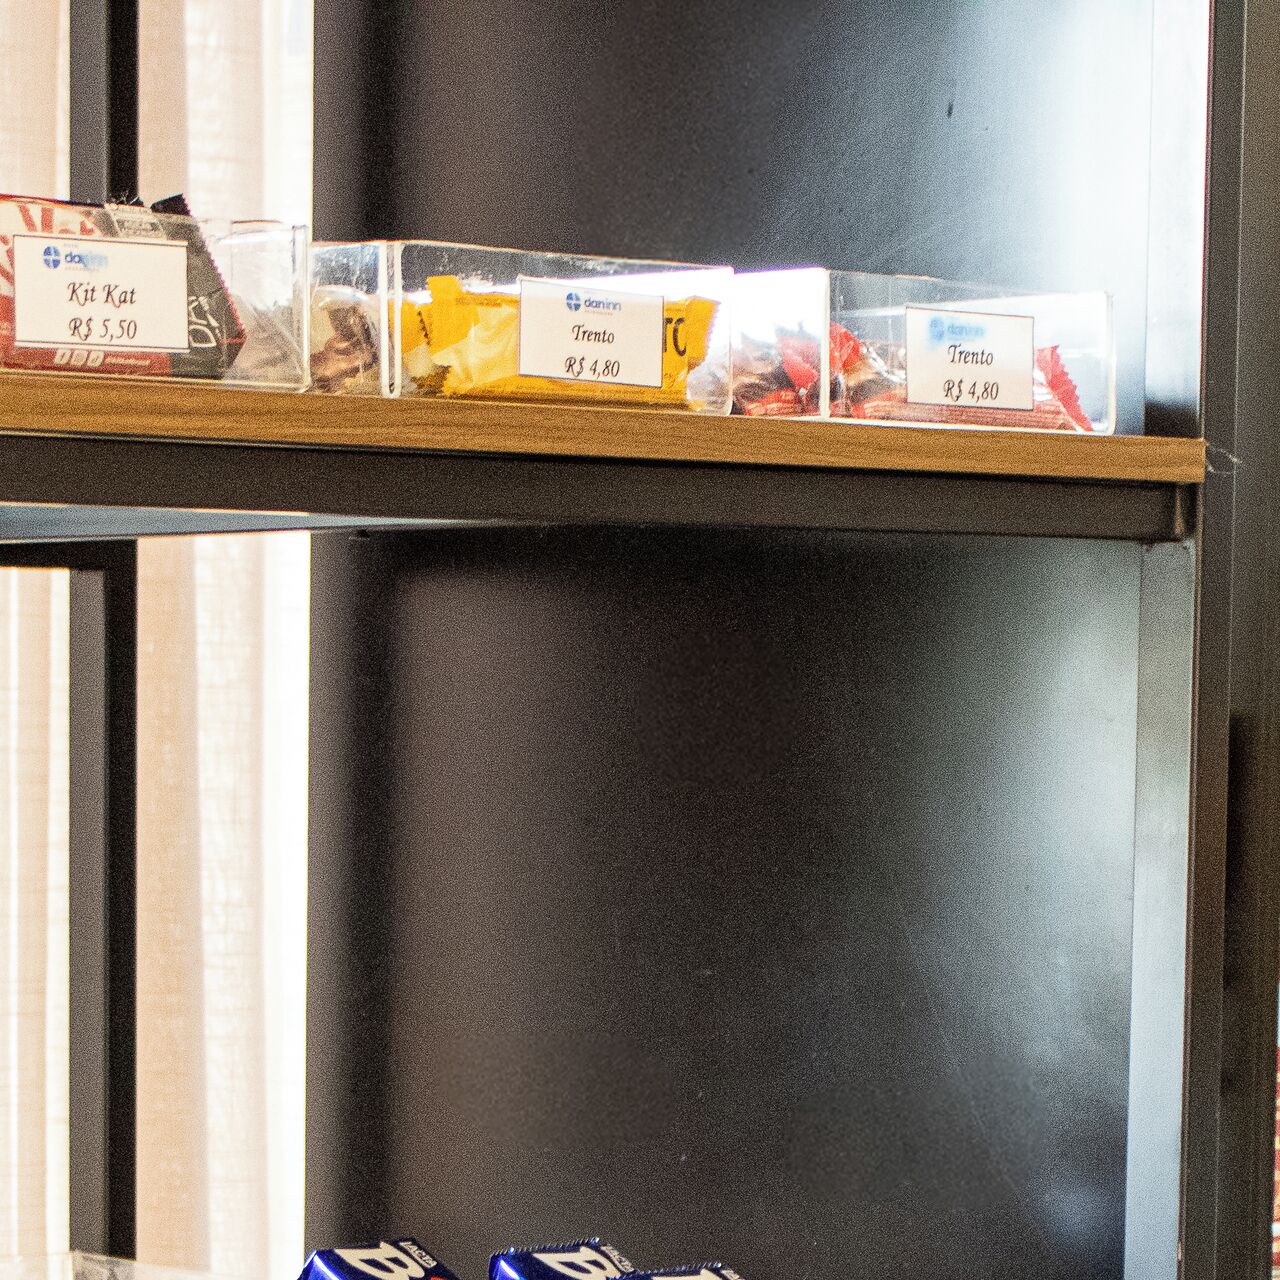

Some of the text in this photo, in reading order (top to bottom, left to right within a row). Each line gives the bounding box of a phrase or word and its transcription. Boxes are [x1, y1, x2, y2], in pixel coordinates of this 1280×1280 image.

[66, 282, 137, 306] Kit Kat
[583, 298, 621, 312] daninn
[68, 318, 138, 341] R$ 5,50
[571, 324, 615, 345] Trento
[947, 344, 994, 367] Trento
[564, 356, 620, 379] R$ 4,80
[943, 379, 999, 403] R$ 4,80
[399, 1241, 438, 1268] LACTA
